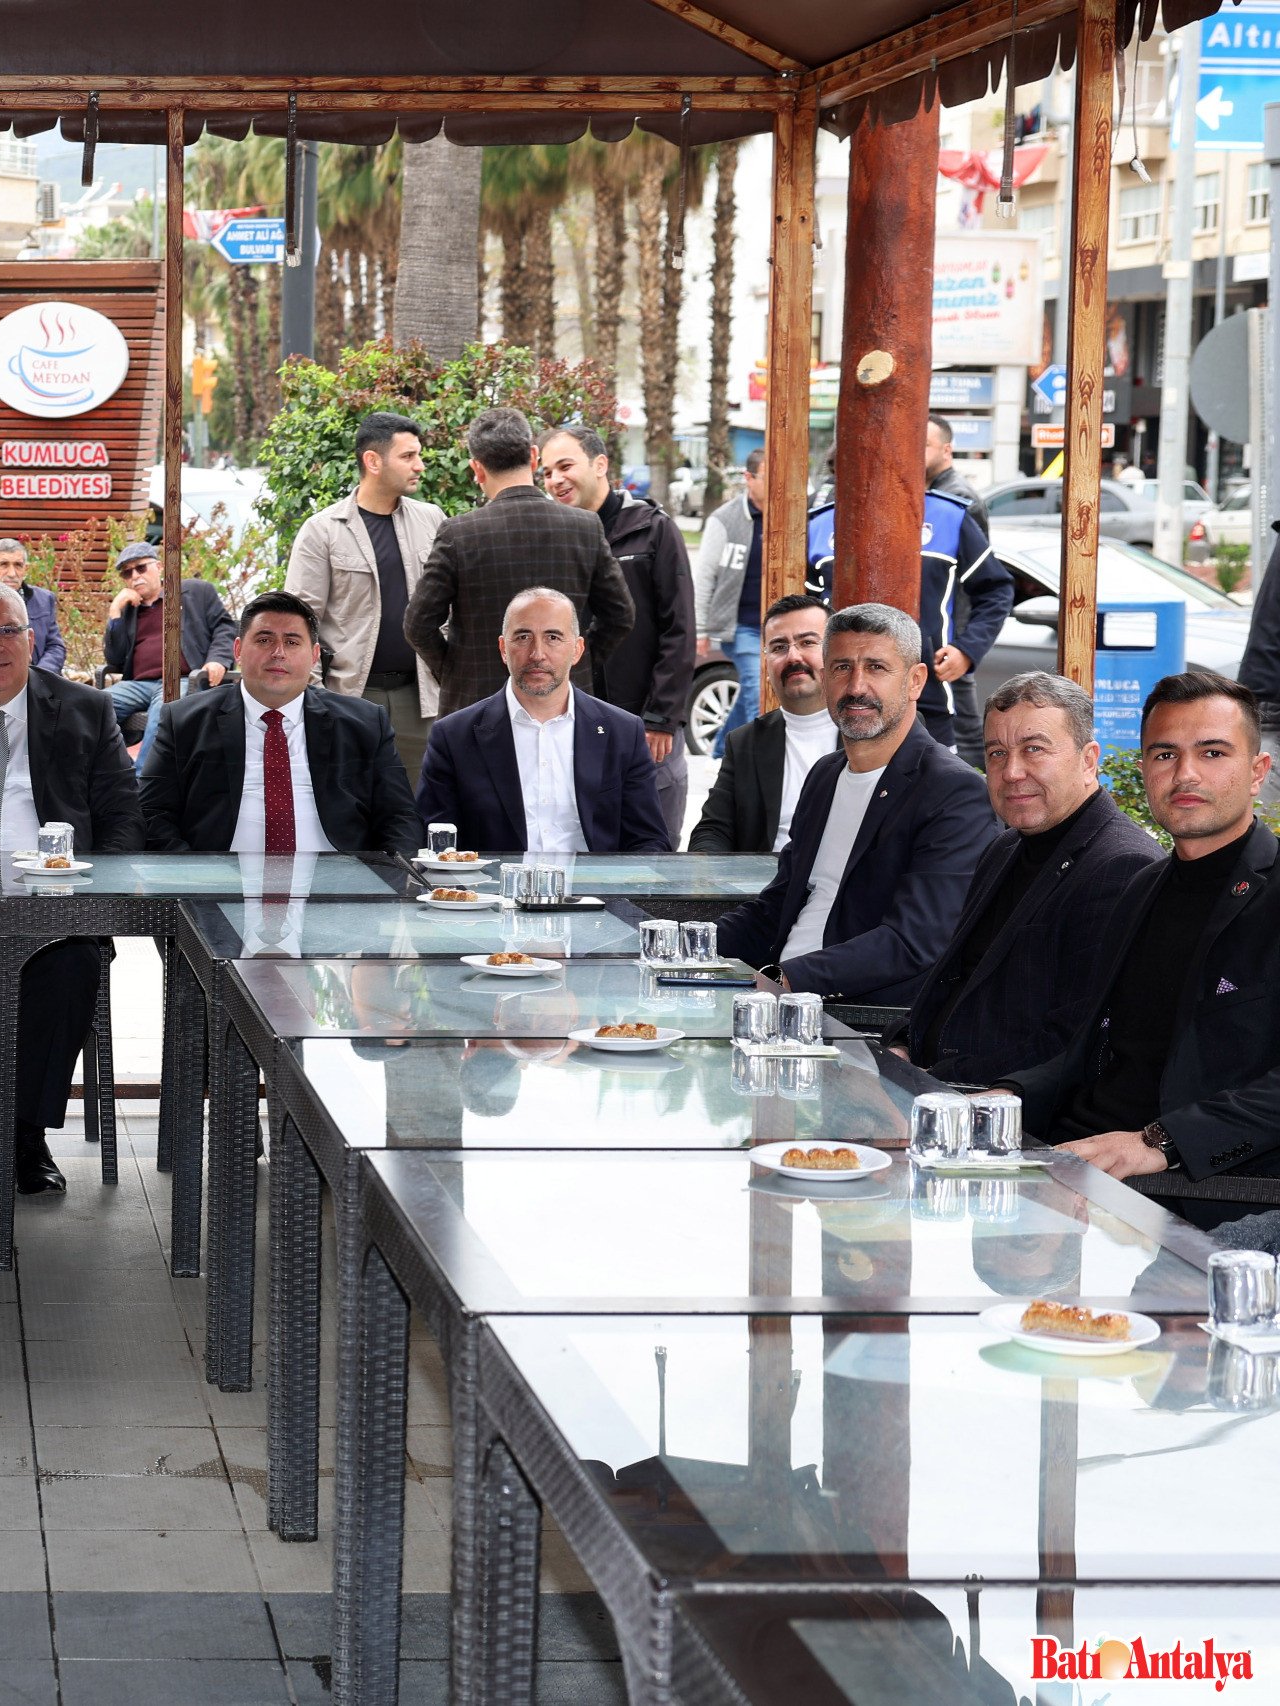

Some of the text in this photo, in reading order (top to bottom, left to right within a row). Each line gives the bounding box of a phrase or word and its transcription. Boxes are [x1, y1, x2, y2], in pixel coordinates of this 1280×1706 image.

[270, 227, 285, 241] AĞ
[32, 360, 59, 370] CAFE
[32, 372, 91, 384] MEYDAN
[3, 444, 108, 465] KUMLUCA
